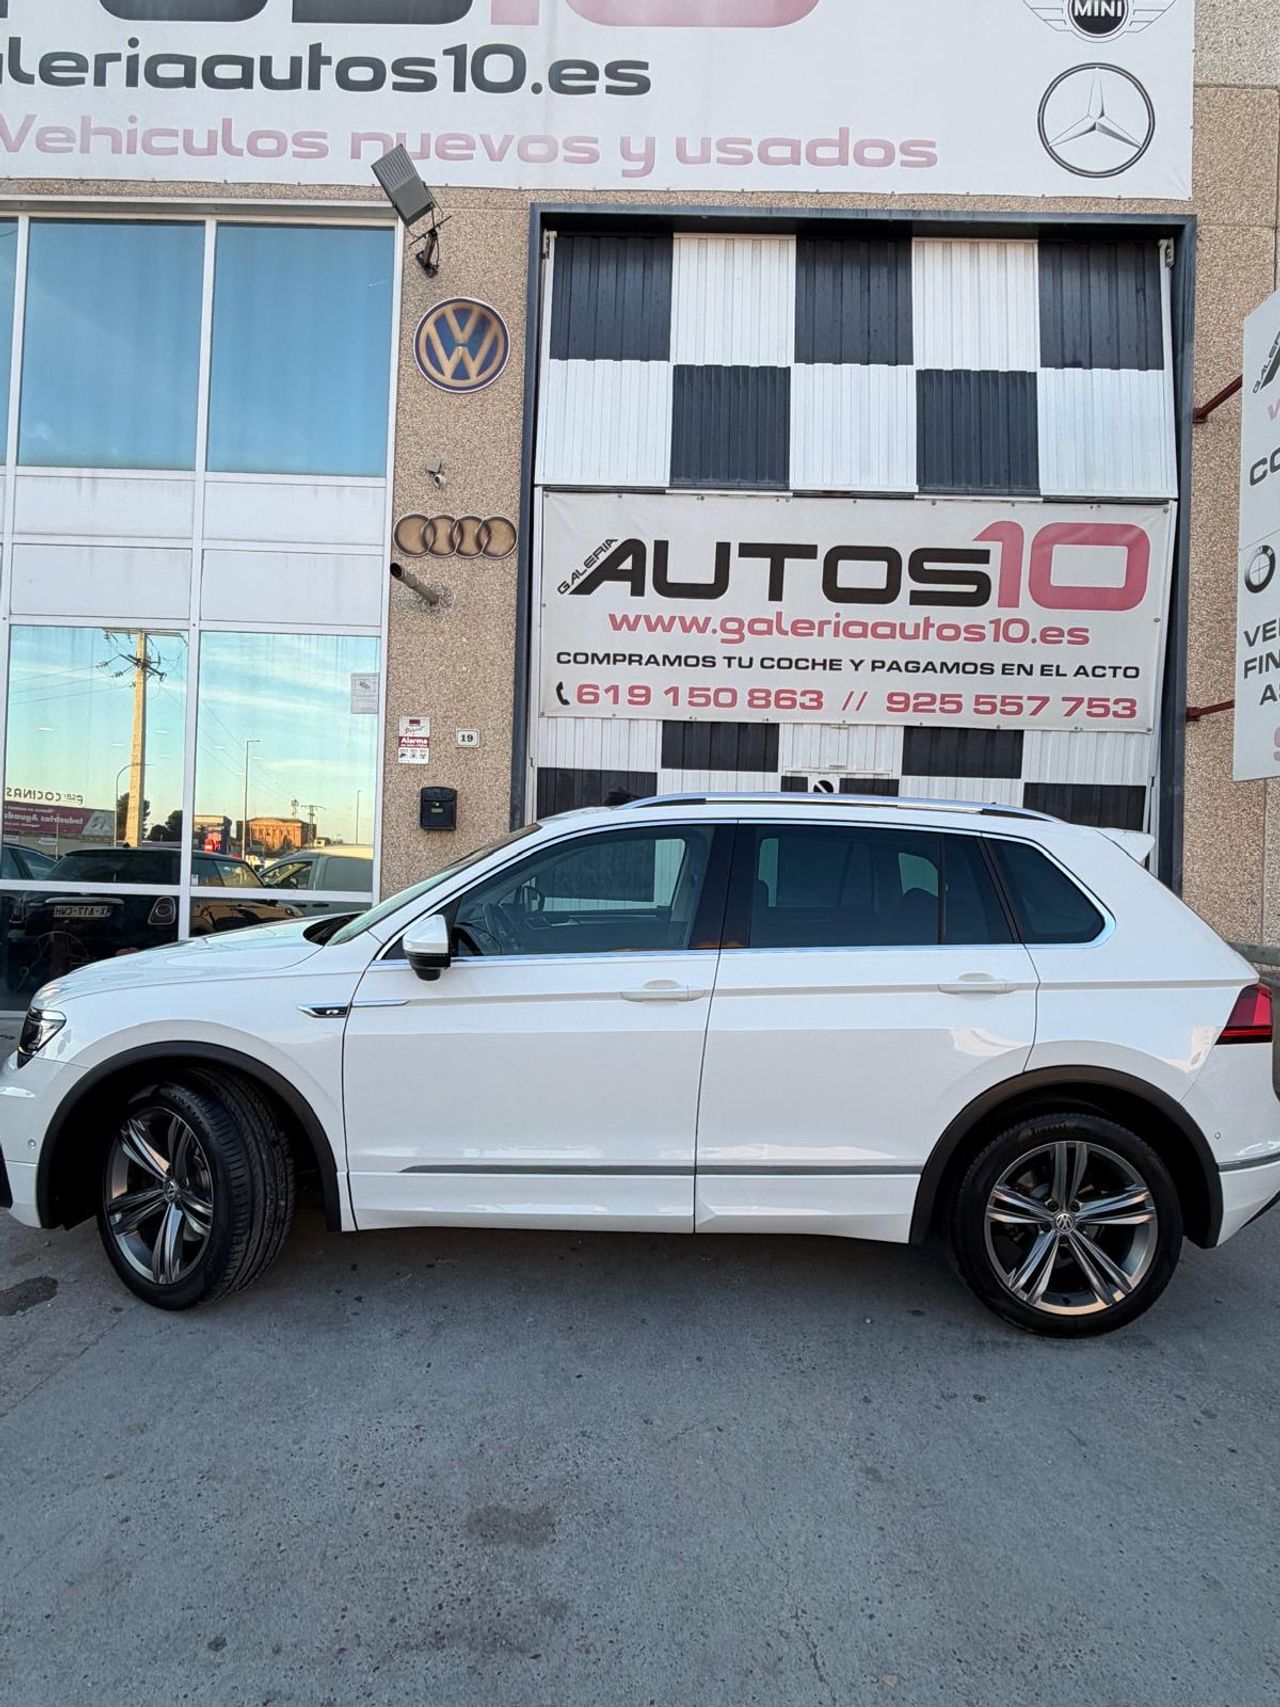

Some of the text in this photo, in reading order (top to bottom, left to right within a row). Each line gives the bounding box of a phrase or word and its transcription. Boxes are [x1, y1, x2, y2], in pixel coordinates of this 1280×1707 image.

[1074, 0, 1122, 17] MINI
[0, 36, 652, 96] leriaautos10.es
[0, 114, 938, 178] Vehiculos nuevos y usados
[557, 538, 618, 595] GALERIA
[608, 611, 1090, 645] www.galeriaautos10.es
[1243, 617, 1280, 648] VE
[556, 651, 1140, 679] COMPRAMOS TU COCHE Y PAGAMOS EN EL ACTO
[577, 683, 651, 706] 619
[663, 686, 744, 709] 150
[748, 688, 824, 711] 863
[886, 691, 963, 714] 925
[973, 694, 1050, 716] 557
[1062, 696, 1137, 719] 753
[460, 733, 474, 743] 19
